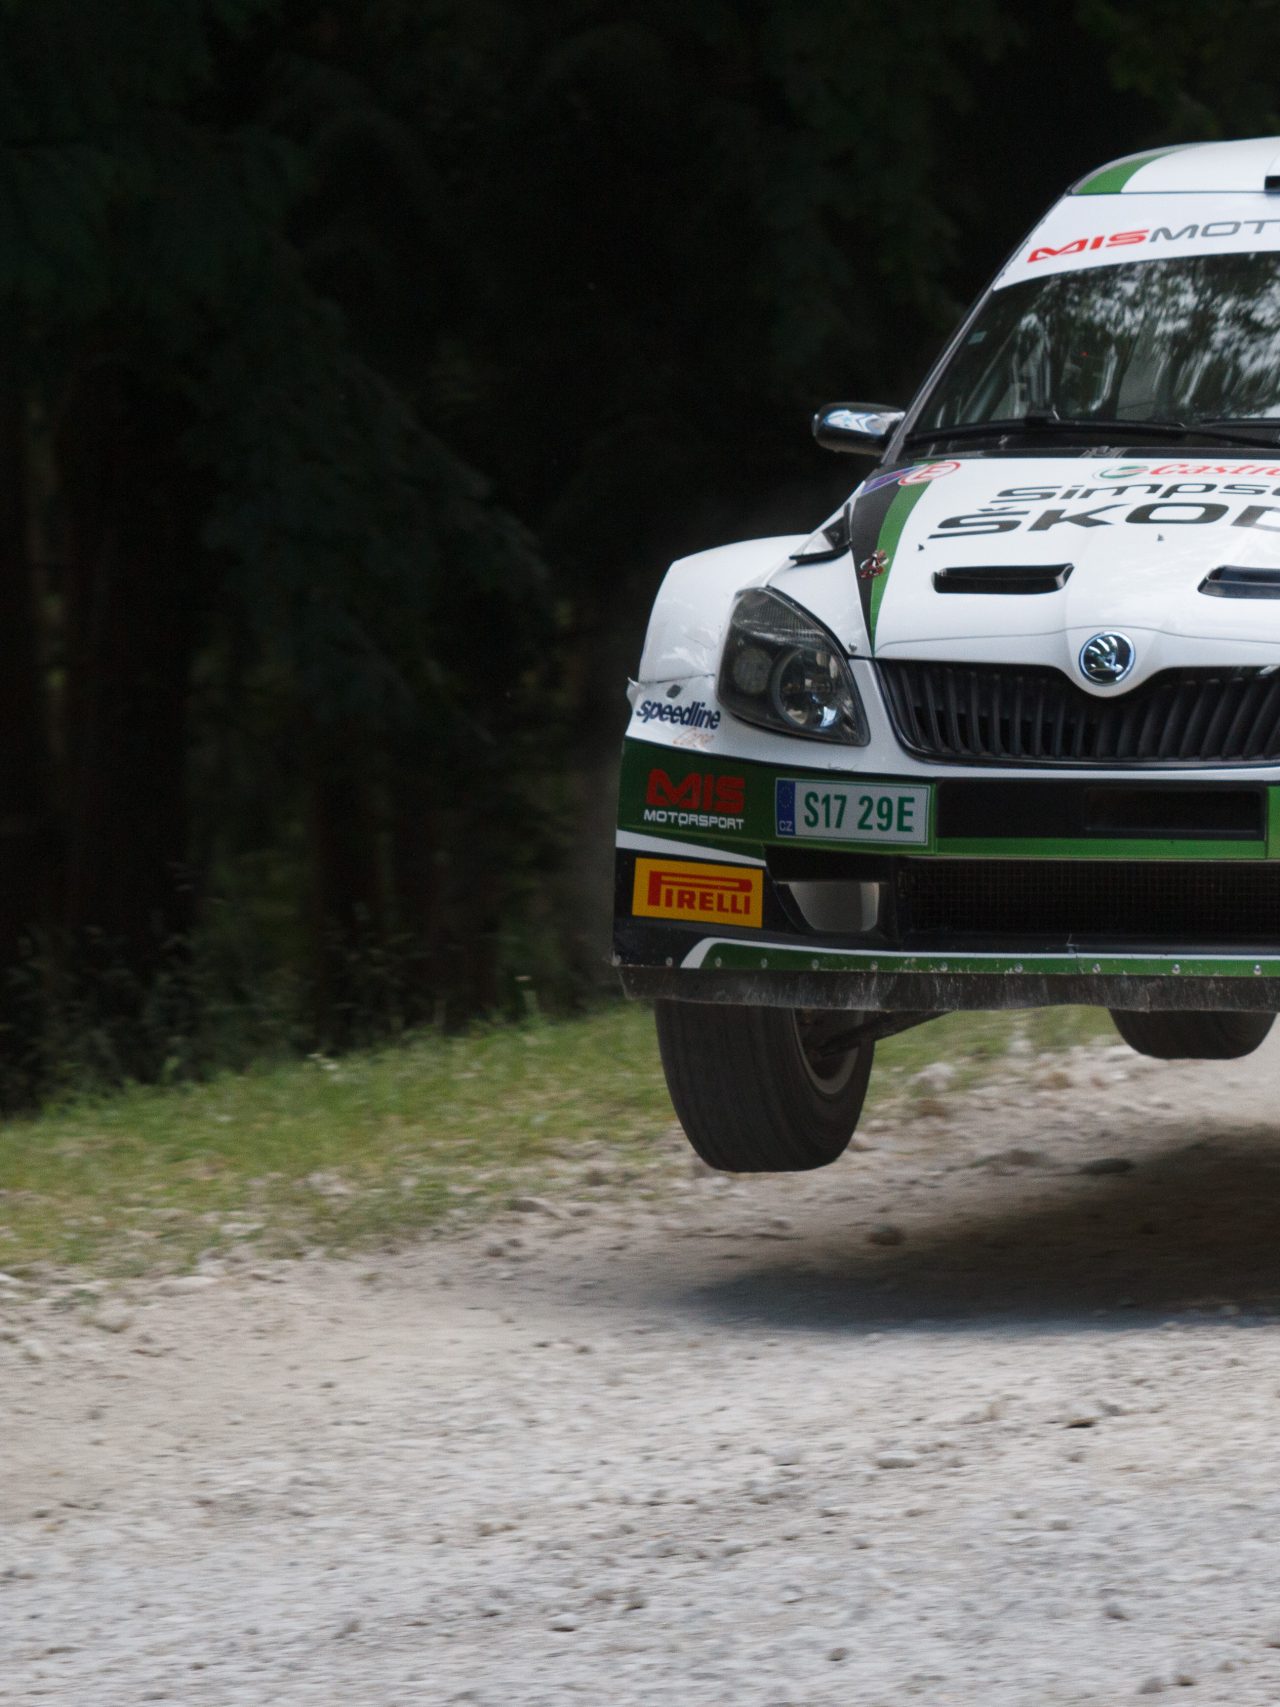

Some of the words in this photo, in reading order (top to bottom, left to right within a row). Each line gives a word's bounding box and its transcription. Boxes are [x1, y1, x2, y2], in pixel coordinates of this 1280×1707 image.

[636, 700, 721, 730] speedline
[646, 768, 746, 815] MIS
[643, 808, 745, 831] MOTORSPORT
[779, 820, 794, 833] CZ
[804, 790, 847, 829] S17
[857, 795, 916, 833] 29E
[647, 870, 753, 916] PIRELLI
